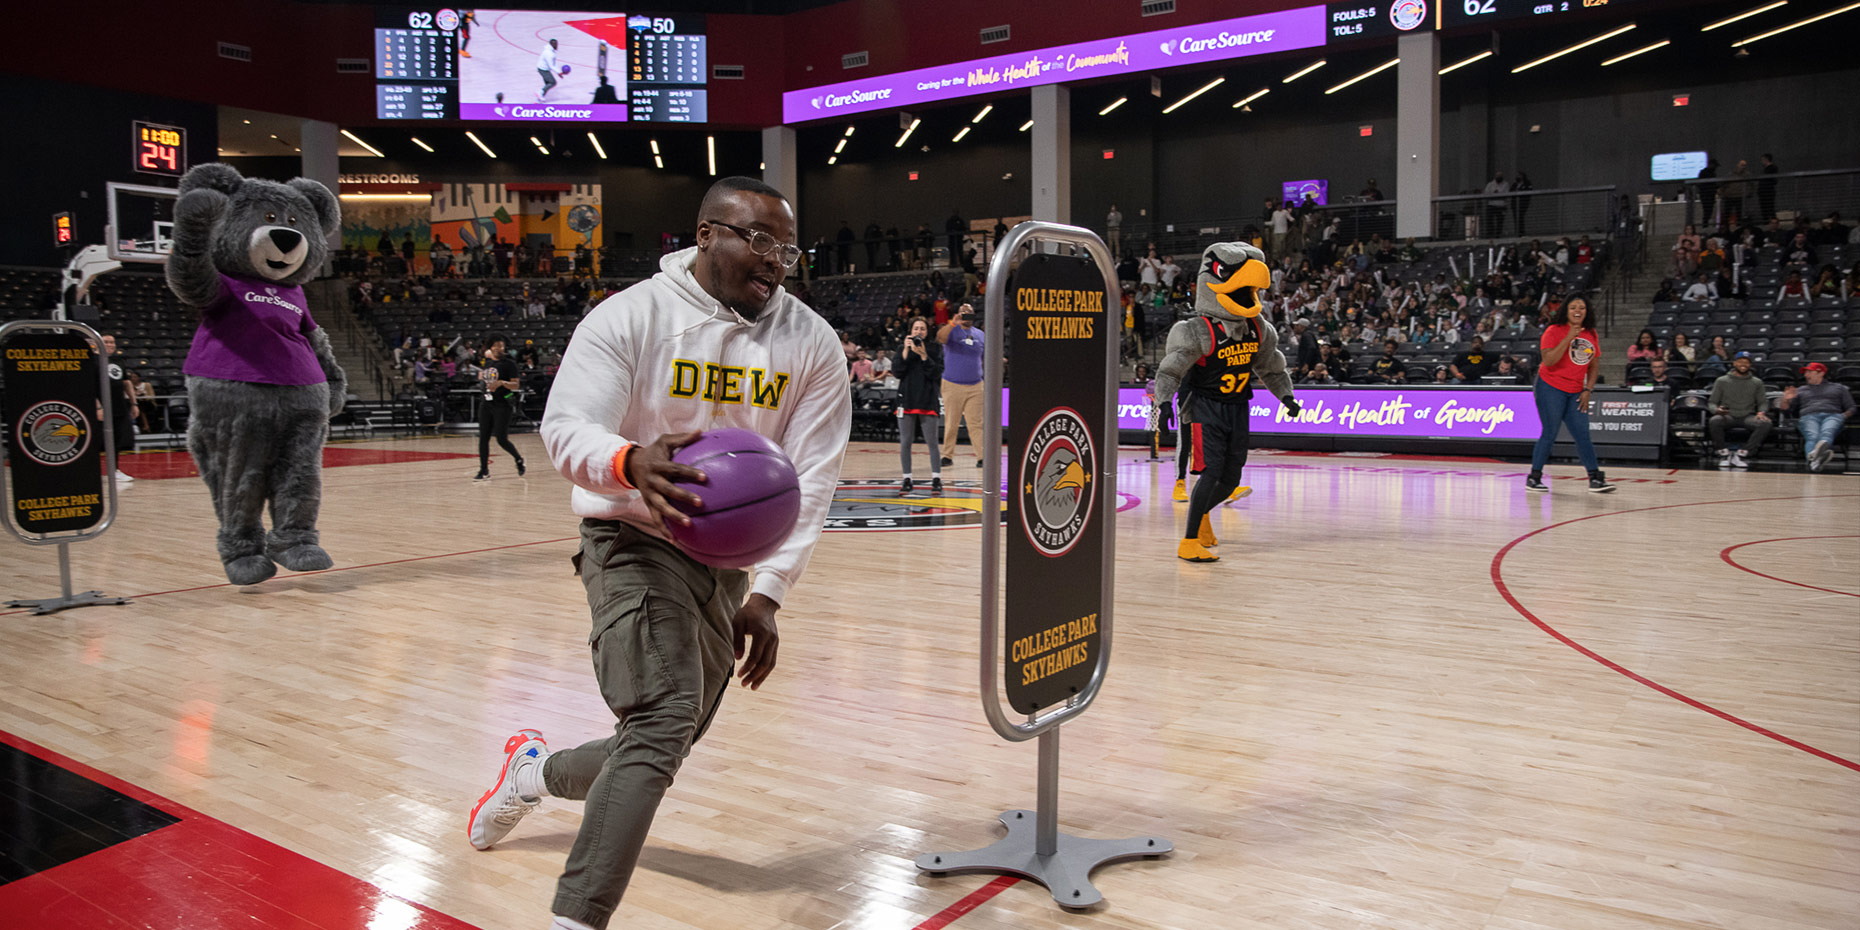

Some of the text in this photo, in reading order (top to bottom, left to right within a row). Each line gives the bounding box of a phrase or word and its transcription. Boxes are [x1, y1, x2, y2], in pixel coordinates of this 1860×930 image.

[1464, 0, 1496, 16] 62
[1533, 2, 1569, 14] QTR 2
[408, 11, 432, 29] 62
[653, 17, 675, 34] 50
[1180, 29, 1275, 54] CareSource
[917, 80, 940, 91] Caring
[941, 78, 952, 87] for
[953, 76, 965, 86] the
[967, 68, 1000, 87] Whole
[1003, 56, 1042, 84] Health
[1042, 62, 1051, 72] of
[825, 89, 892, 108] CareSource
[511, 106, 592, 118] CareSource
[141, 128, 180, 146] 11:00
[141, 142, 176, 170] 24
[338, 173, 420, 184] RESTROOMS
[245, 291, 304, 316] CareSource
[1017, 287, 1103, 313] COLLEGE PARK
[1027, 316, 1094, 339] SKYHAWKS
[6, 348, 90, 360] COLLEGE PARK
[1217, 342, 1259, 359] COLLEGE
[17, 360, 81, 372] SKYHAWKS
[1226, 353, 1252, 367] PARK
[669, 358, 790, 410] DREW
[1219, 372, 1250, 394] 37
[25, 405, 82, 425] COLLEGE PARK
[1250, 404, 1271, 417] the
[1338, 395, 1412, 429] Health
[1414, 407, 1431, 419] of
[1435, 399, 1515, 434] Georgia
[1601, 408, 1654, 417] WEATHER
[1604, 422, 1619, 431] YOU
[1621, 422, 1643, 431] FIRST
[1029, 418, 1089, 464] COLLEGE PARK
[18, 494, 100, 510] COLLEGE PARK
[28, 506, 92, 521] SKYHAWKS
[1033, 514, 1082, 546] SKYHAWKS
[1012, 613, 1097, 663] COLLEGE PARK
[1022, 641, 1088, 686] SKYHAWKS
